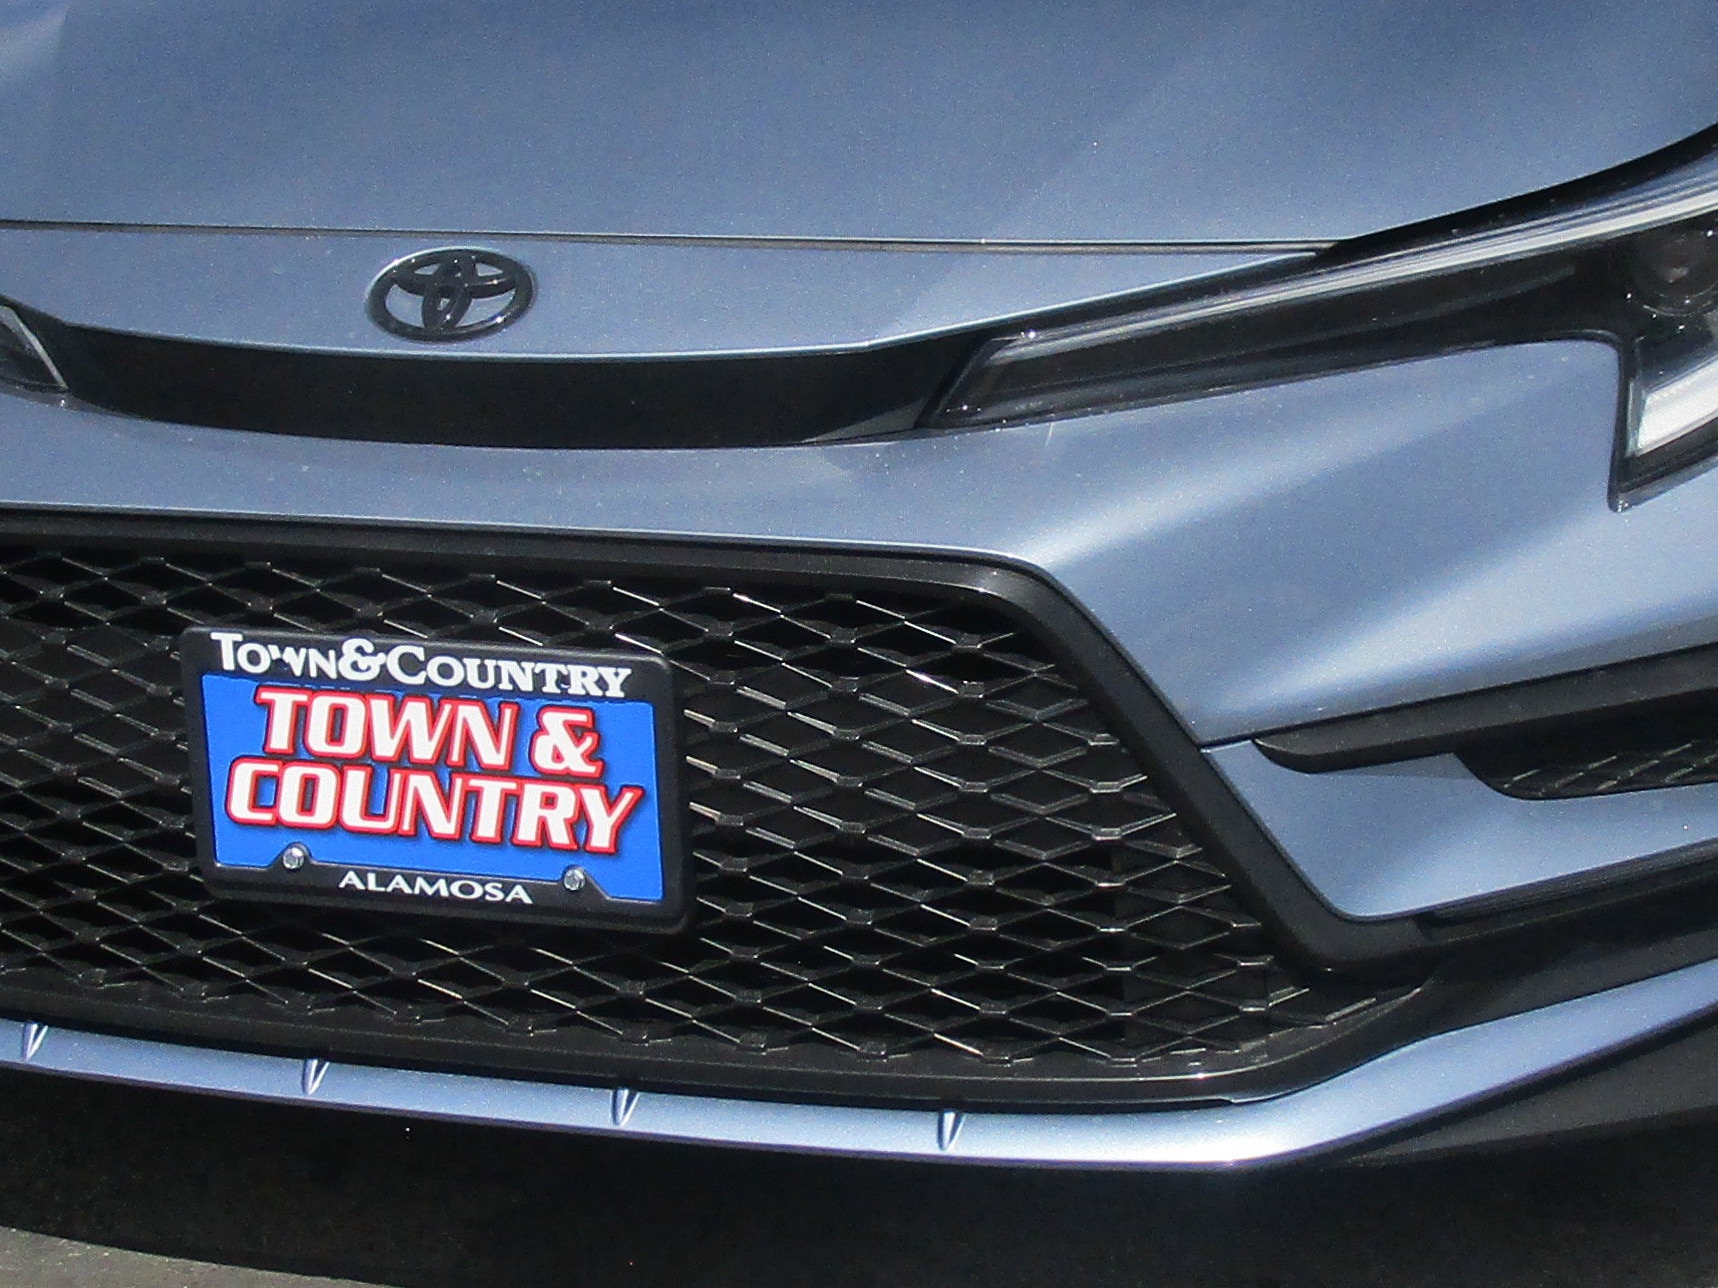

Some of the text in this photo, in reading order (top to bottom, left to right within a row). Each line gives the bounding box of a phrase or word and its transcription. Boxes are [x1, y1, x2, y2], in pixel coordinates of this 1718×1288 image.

[254, 685, 604, 778] TOWN &
[226, 756, 644, 854] COUNTRY
[339, 869, 533, 905] ALAMOSA
